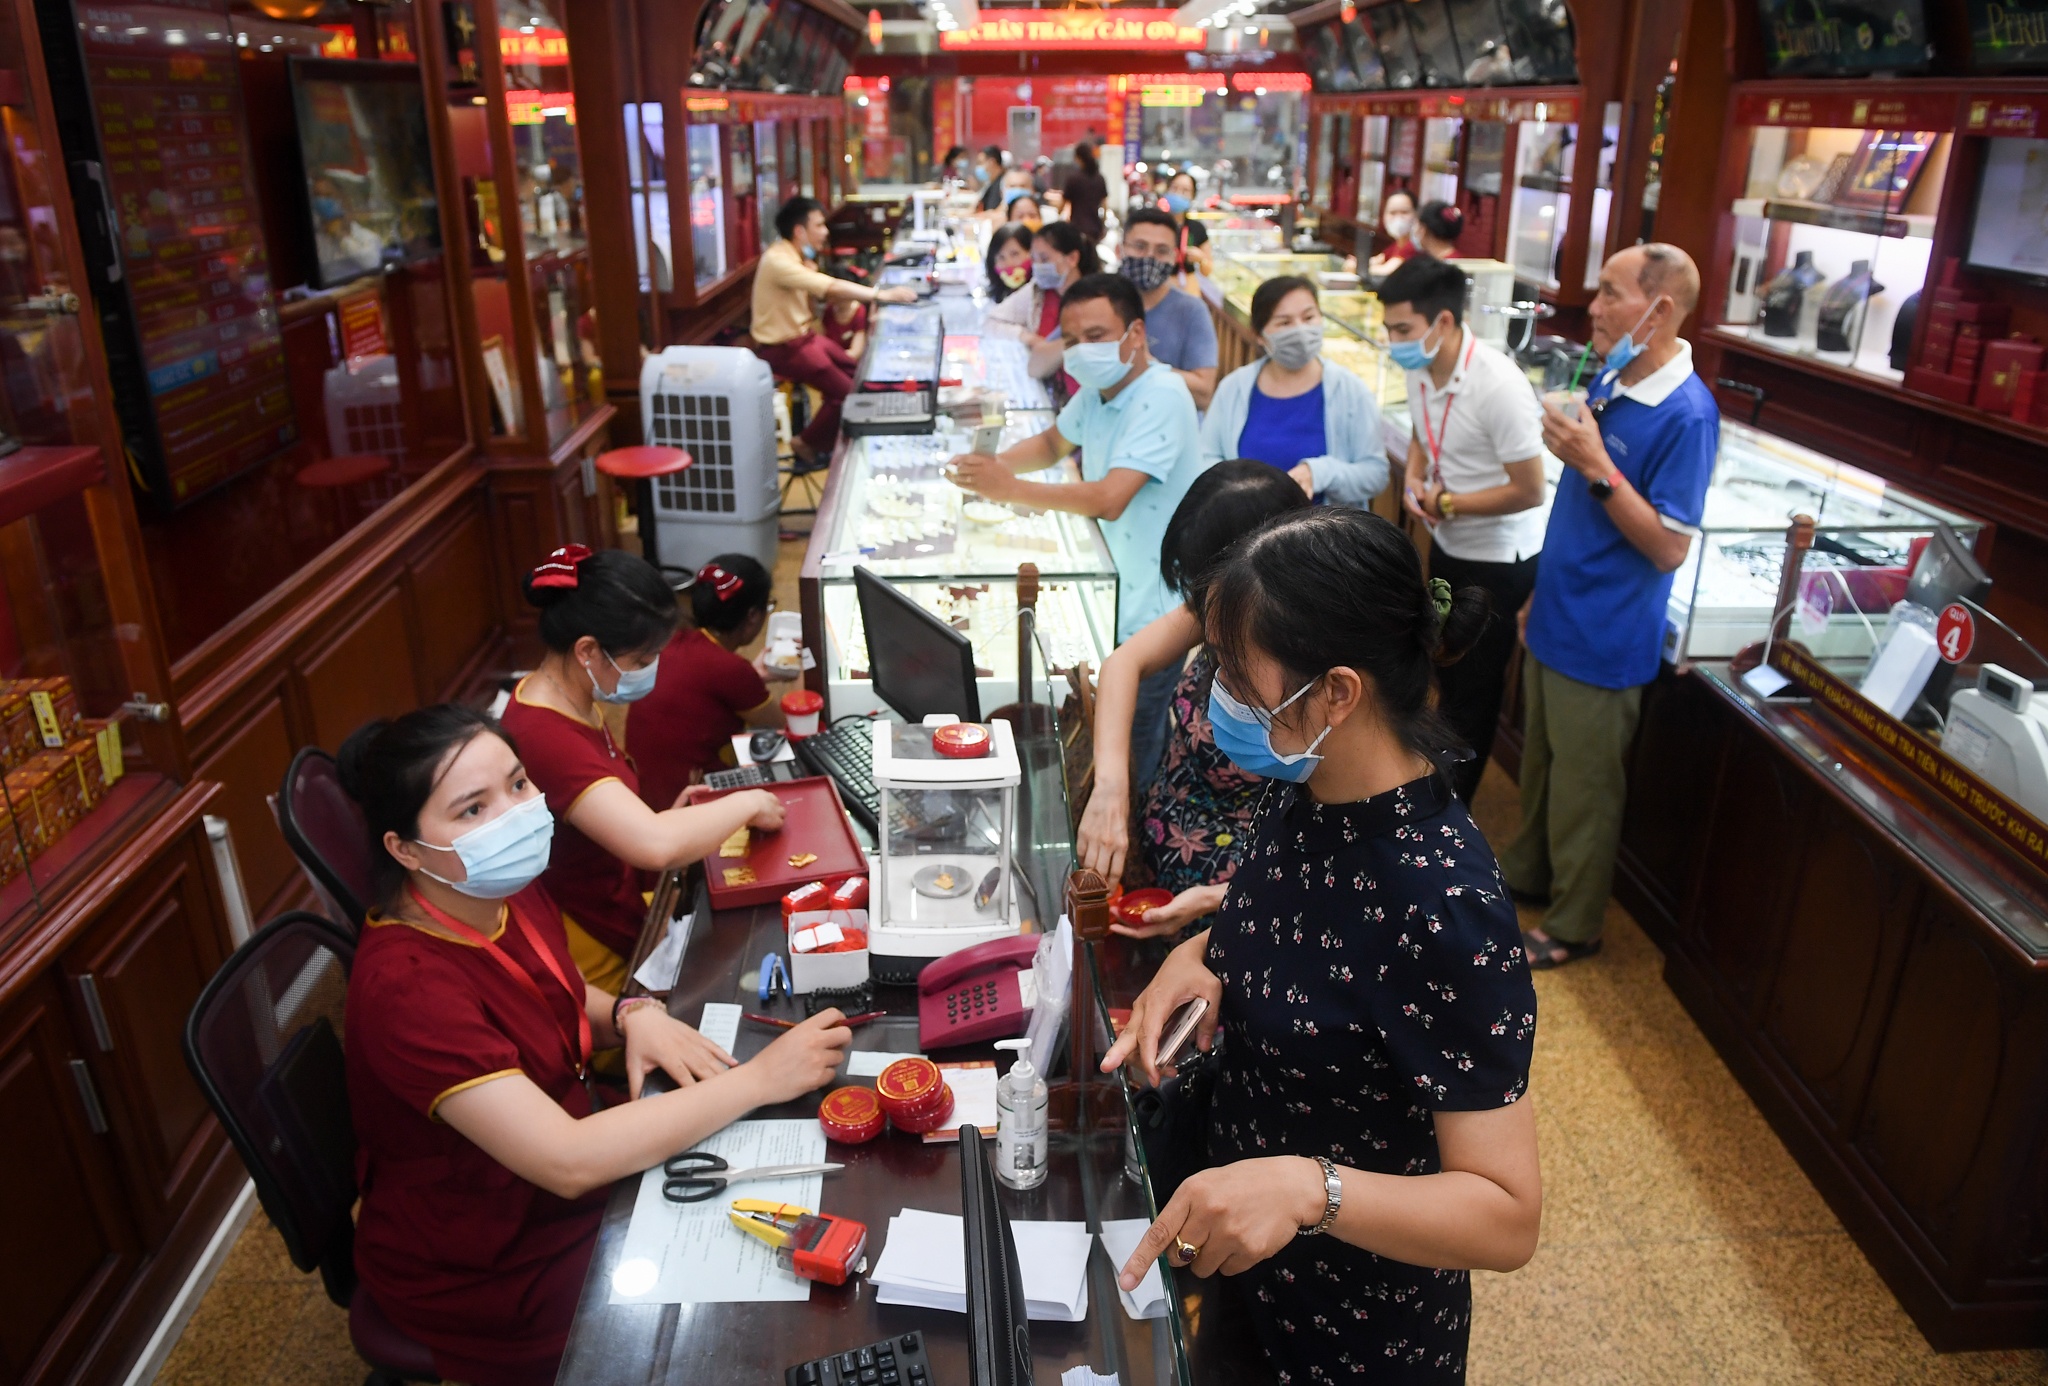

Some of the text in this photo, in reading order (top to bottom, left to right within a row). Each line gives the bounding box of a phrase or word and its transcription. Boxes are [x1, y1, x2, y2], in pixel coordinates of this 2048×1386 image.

[1942, 626, 1961, 659] 4
[2007, 817, 2028, 843] KHI
[2028, 831, 2044, 854] RA
